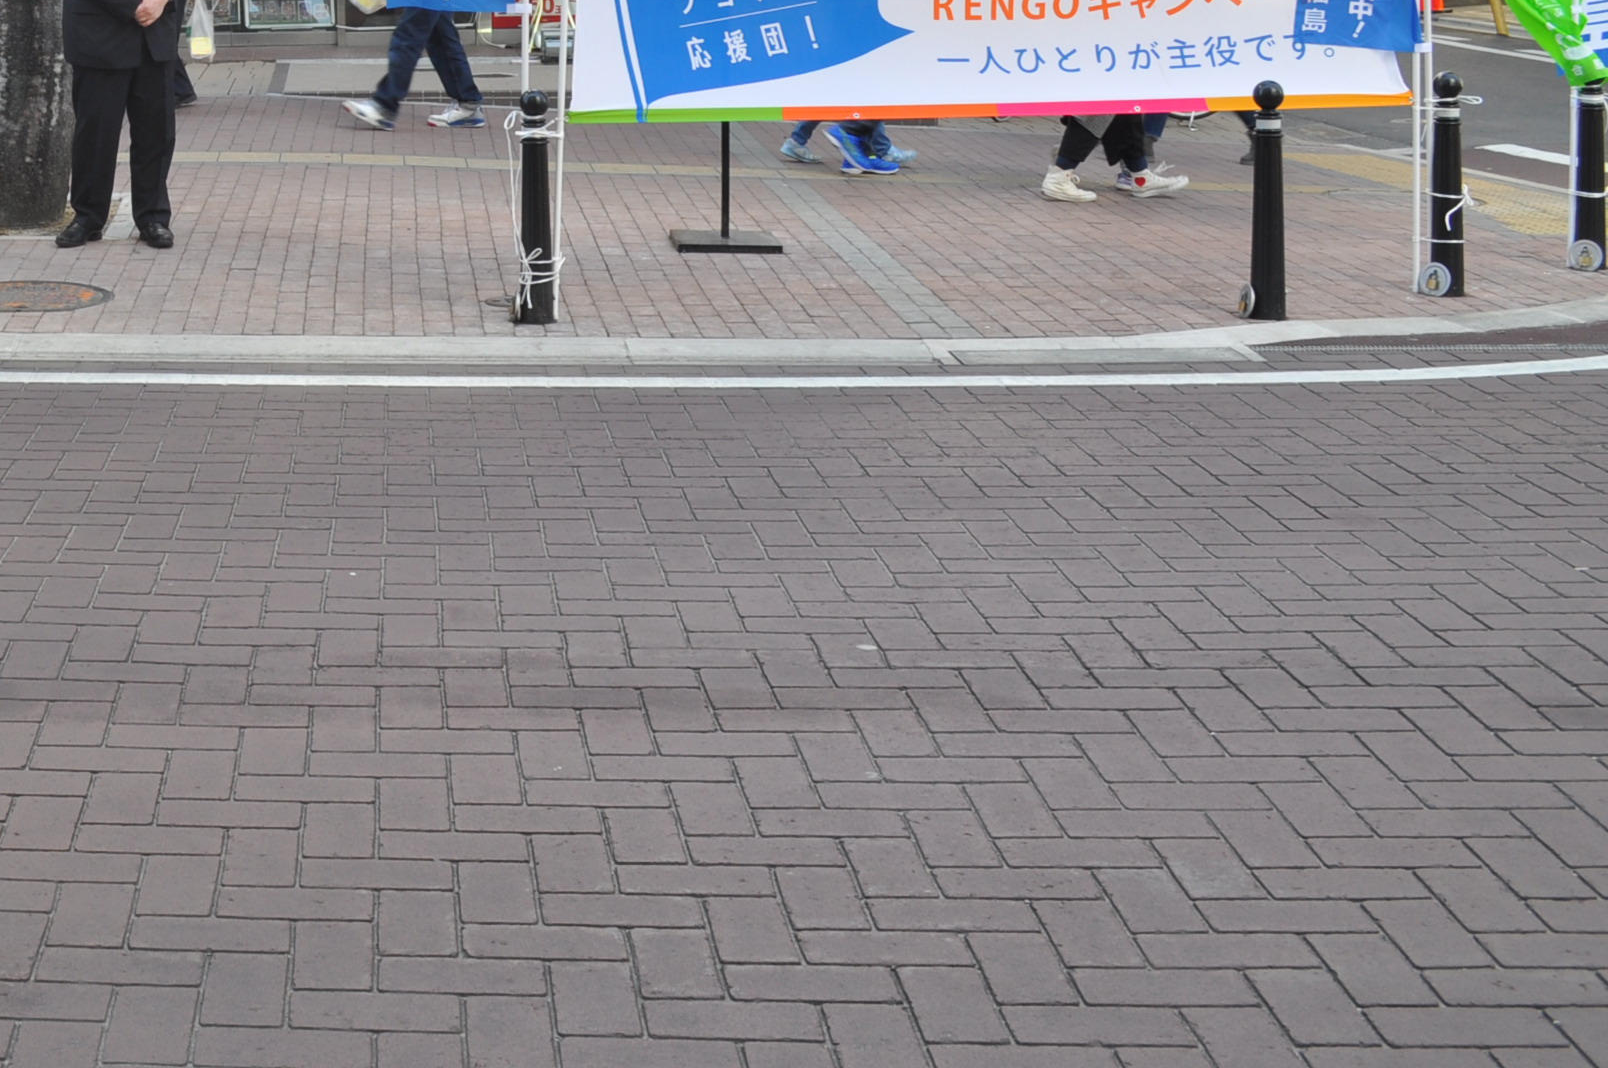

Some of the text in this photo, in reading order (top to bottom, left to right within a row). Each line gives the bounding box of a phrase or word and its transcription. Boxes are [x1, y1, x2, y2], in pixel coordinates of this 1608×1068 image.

[686, 15, 821, 71] 応援団！
[937, 32, 1336, 76] 一人ひとりが主役です。
